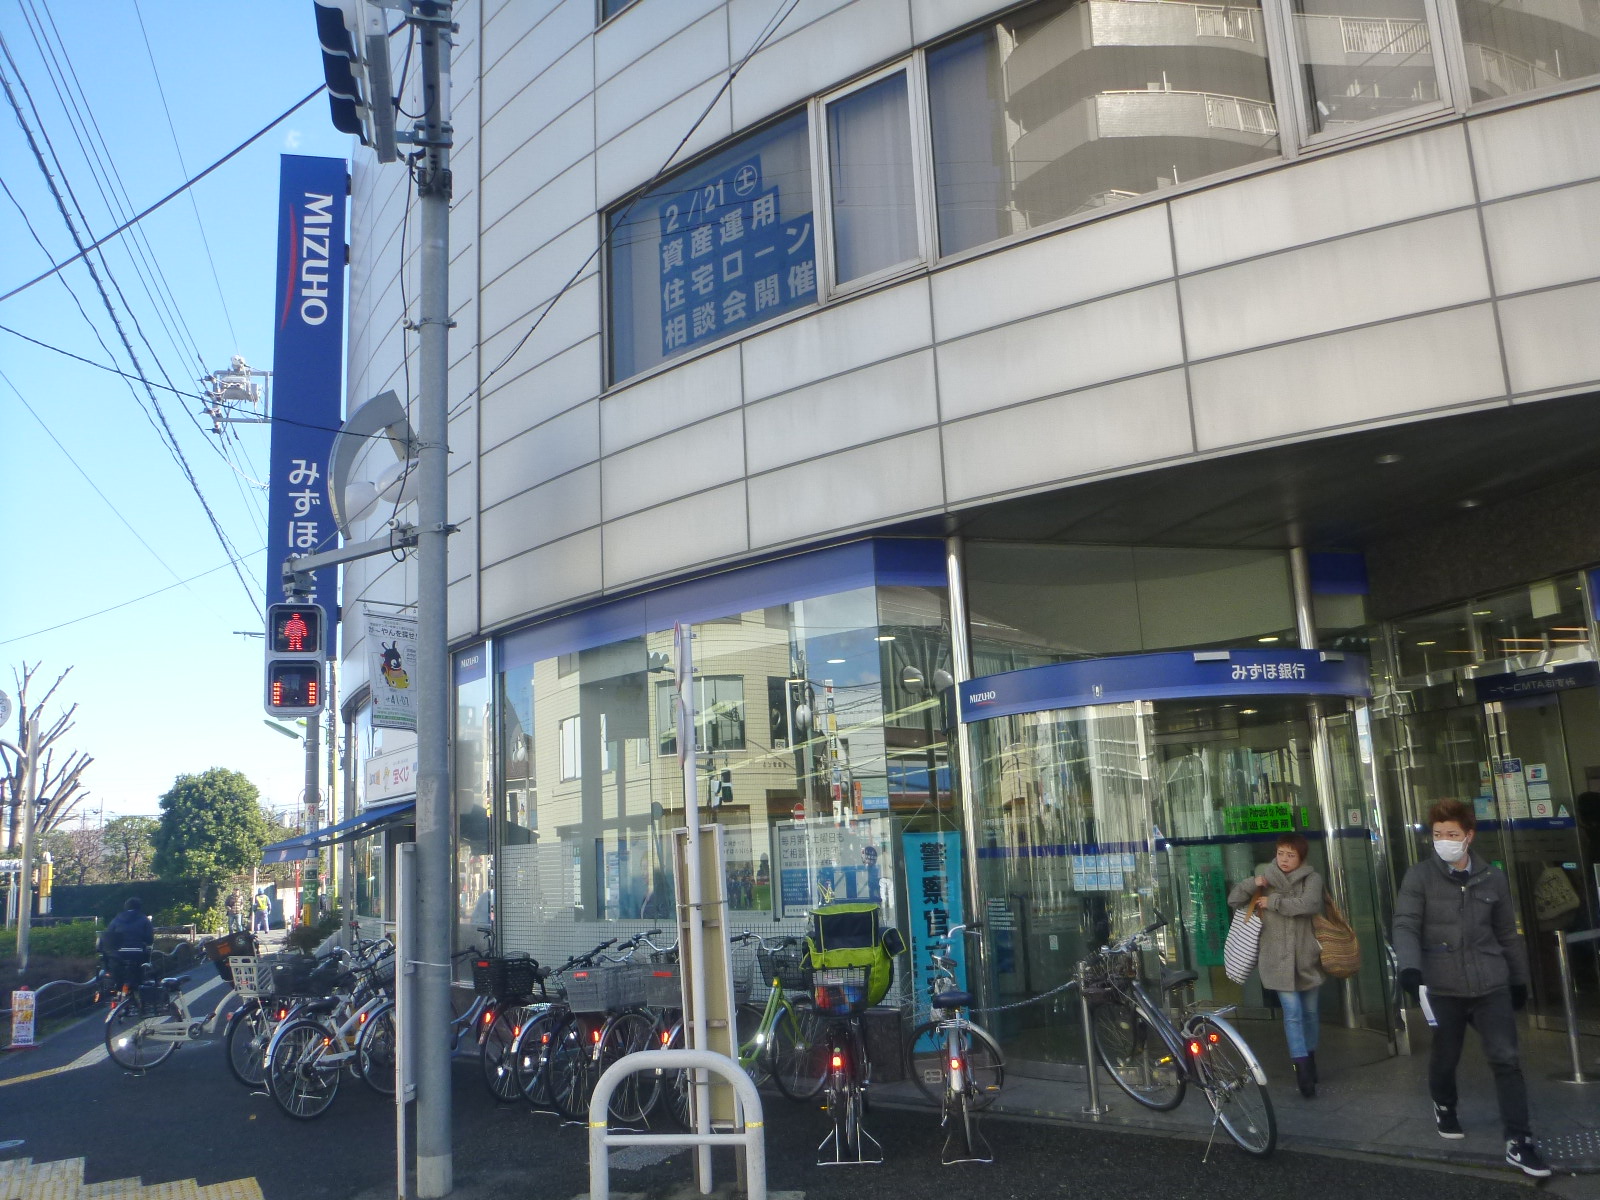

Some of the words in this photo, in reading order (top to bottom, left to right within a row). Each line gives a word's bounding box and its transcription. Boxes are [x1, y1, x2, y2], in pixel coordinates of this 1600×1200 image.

[300, 192, 334, 326] MIZUHO
[662, 193, 776, 274] 資産運用
[663, 223, 811, 312] 住宅ローン
[664, 260, 816, 350] 相談会開催
[969, 689, 996, 704] MIZUHO
[1231, 662, 1306, 680] みずほ銀行
